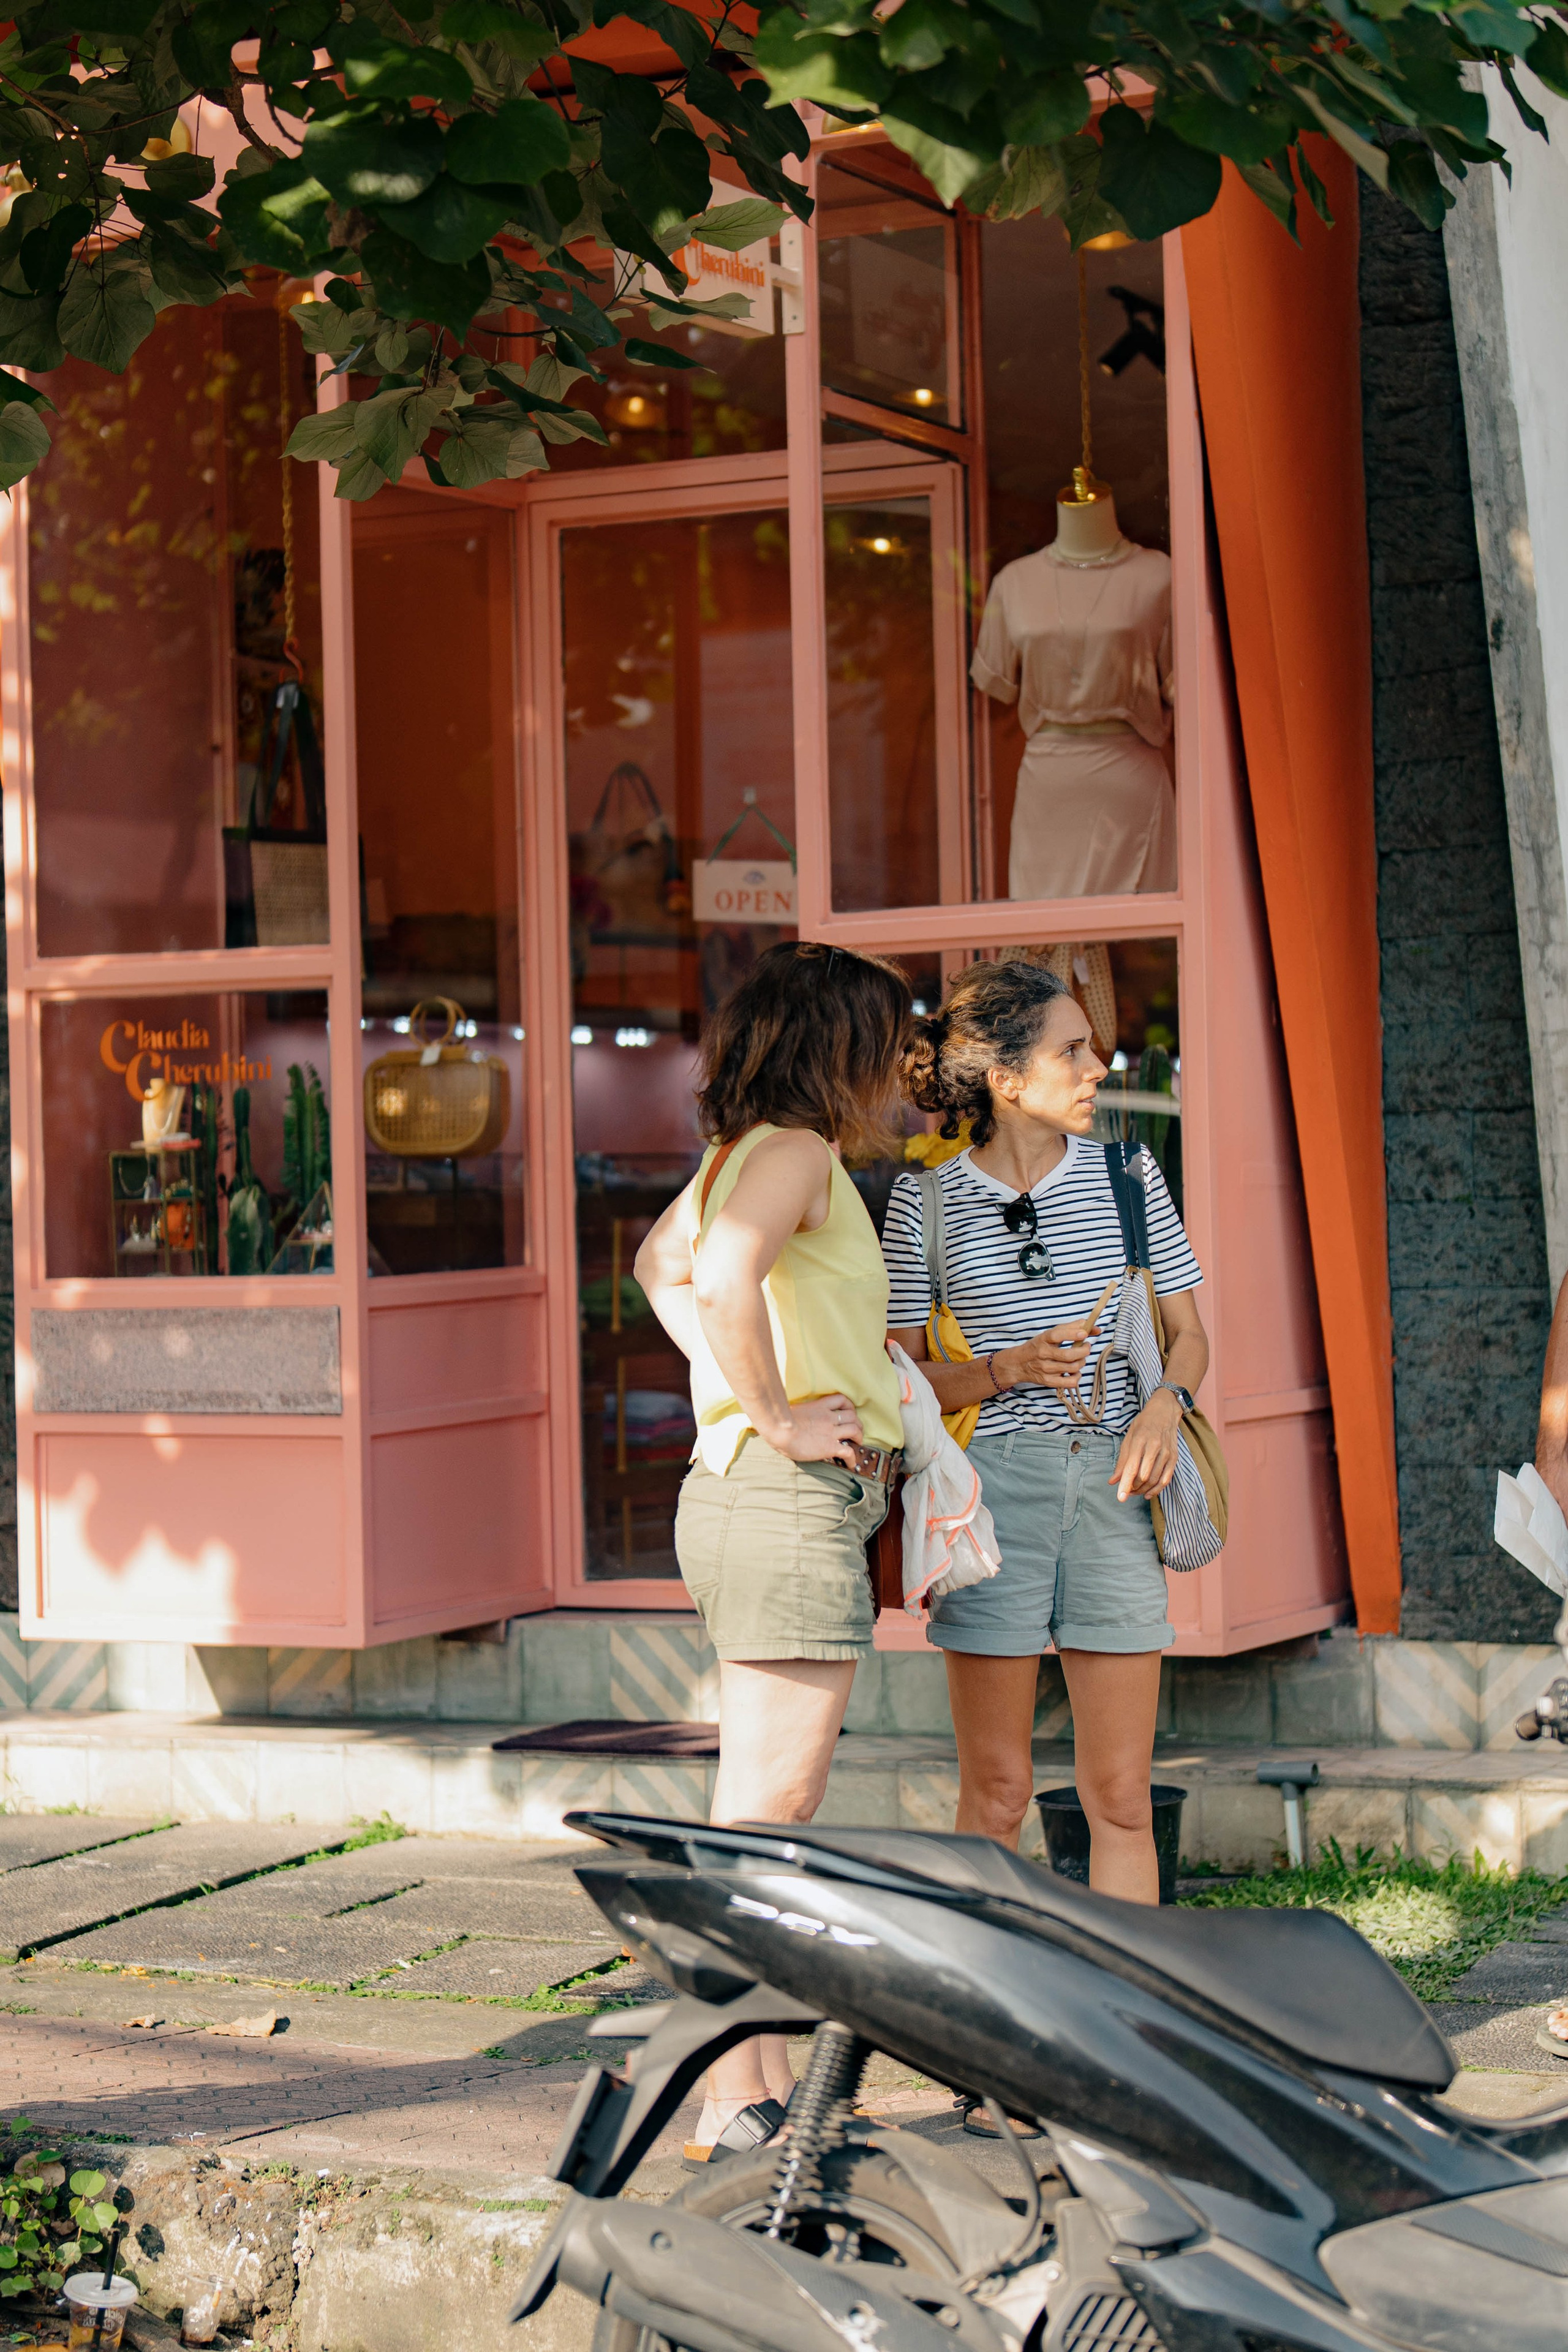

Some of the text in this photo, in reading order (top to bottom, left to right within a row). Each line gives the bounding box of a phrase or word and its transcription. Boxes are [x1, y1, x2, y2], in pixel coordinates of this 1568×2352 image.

[714, 889, 793, 913] OPEN
[99, 1019, 210, 1074] Claudia
[125, 1050, 272, 1102] Cherubini
